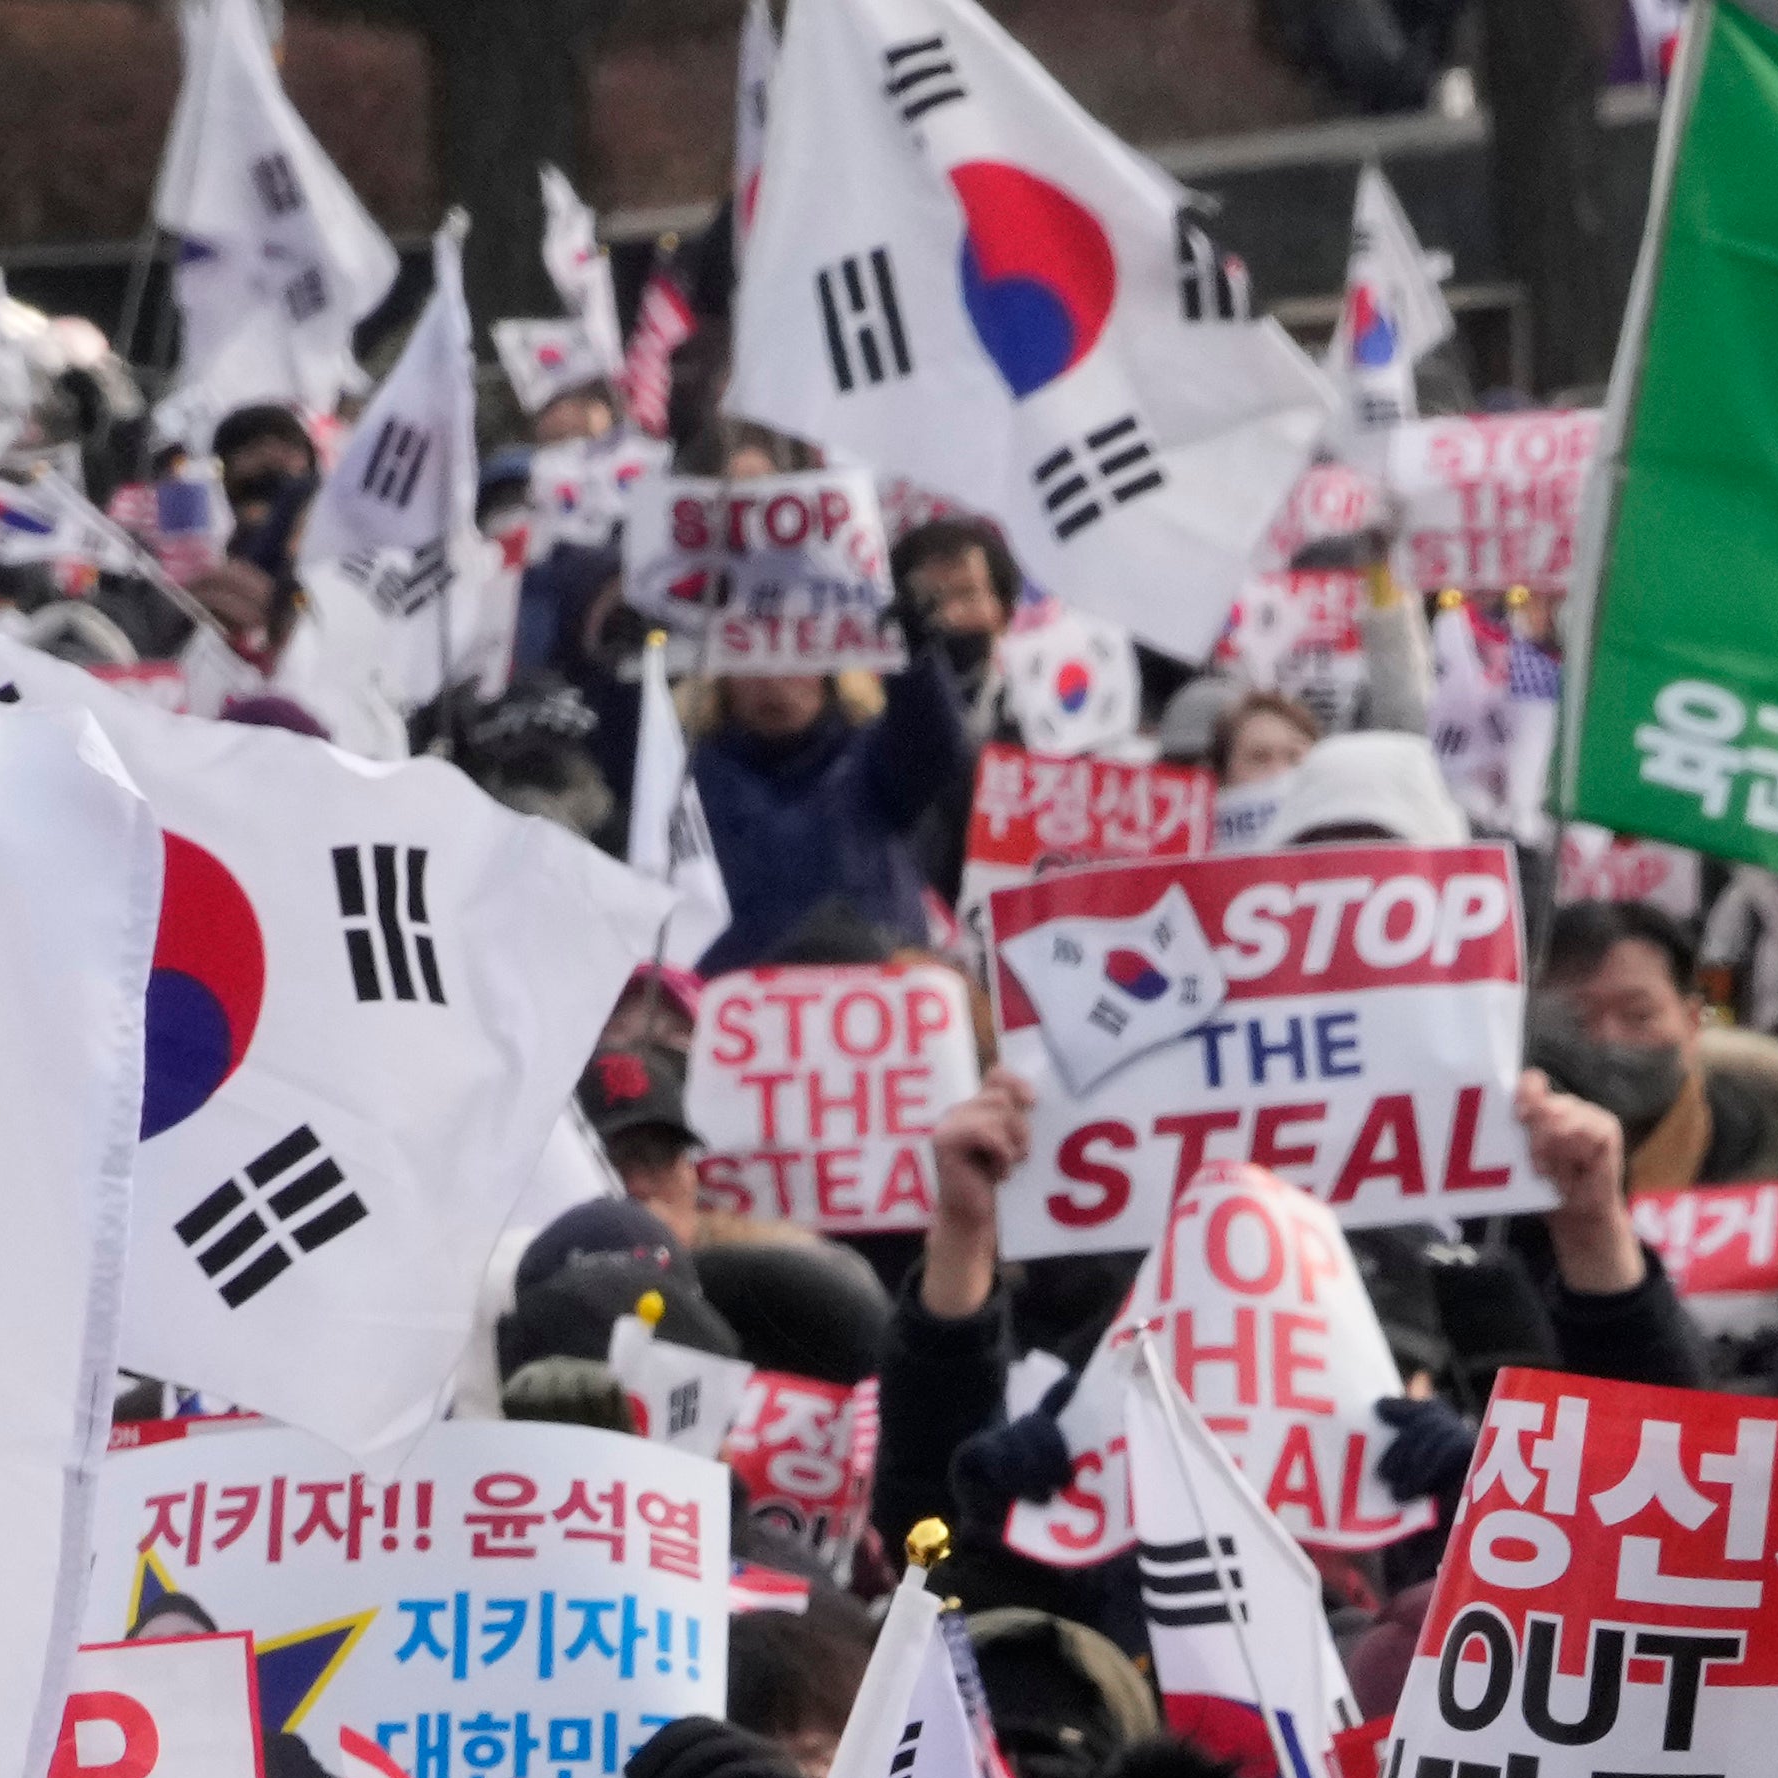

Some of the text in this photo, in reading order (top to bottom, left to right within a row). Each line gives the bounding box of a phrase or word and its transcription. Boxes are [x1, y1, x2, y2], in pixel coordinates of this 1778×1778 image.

[672, 490, 851, 551] STOP
[975, 750, 1213, 857] 부정선거
[1221, 868, 1512, 982] STOP
[711, 990, 950, 1066] STOP
[1193, 1009, 1363, 1091] THE
[739, 1068, 935, 1142] THE
[695, 1147, 934, 1219] STEA
[1045, 1085, 1512, 1229] STEAL
[1158, 1194, 1341, 1302] TOP
[139, 1472, 436, 1567] 지키자!!
[463, 1472, 704, 1581] 윤석열
[395, 1591, 703, 1682] 지키자!!
[1438, 1606, 1745, 1752] OUT
